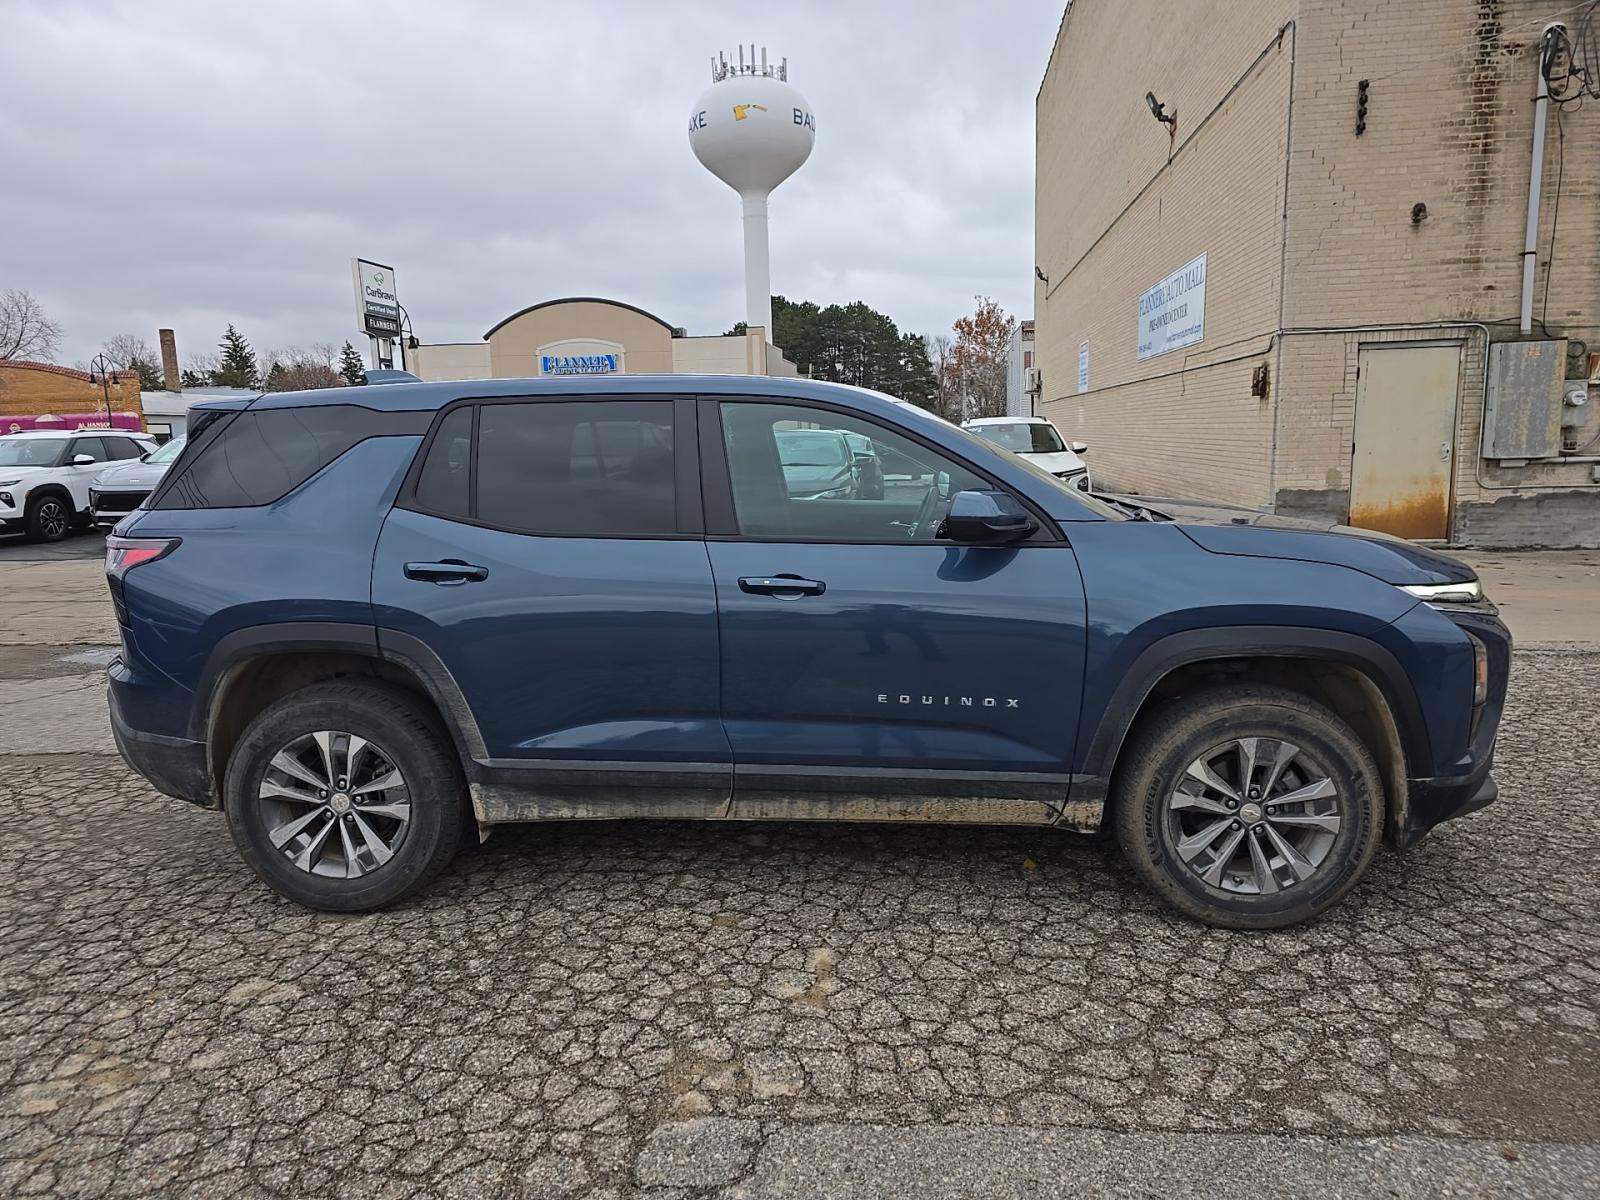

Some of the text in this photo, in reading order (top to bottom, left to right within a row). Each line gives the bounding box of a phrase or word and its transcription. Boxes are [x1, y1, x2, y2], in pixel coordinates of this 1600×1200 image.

[1166, 275, 1184, 301] AUTO
[1184, 263, 1204, 292] MALL
[365, 286, 395, 301] CarBravo
[369, 318, 397, 331] FLANNERY
[543, 354, 616, 372] FLANNERY
[877, 694, 1019, 708] EQUINOX
